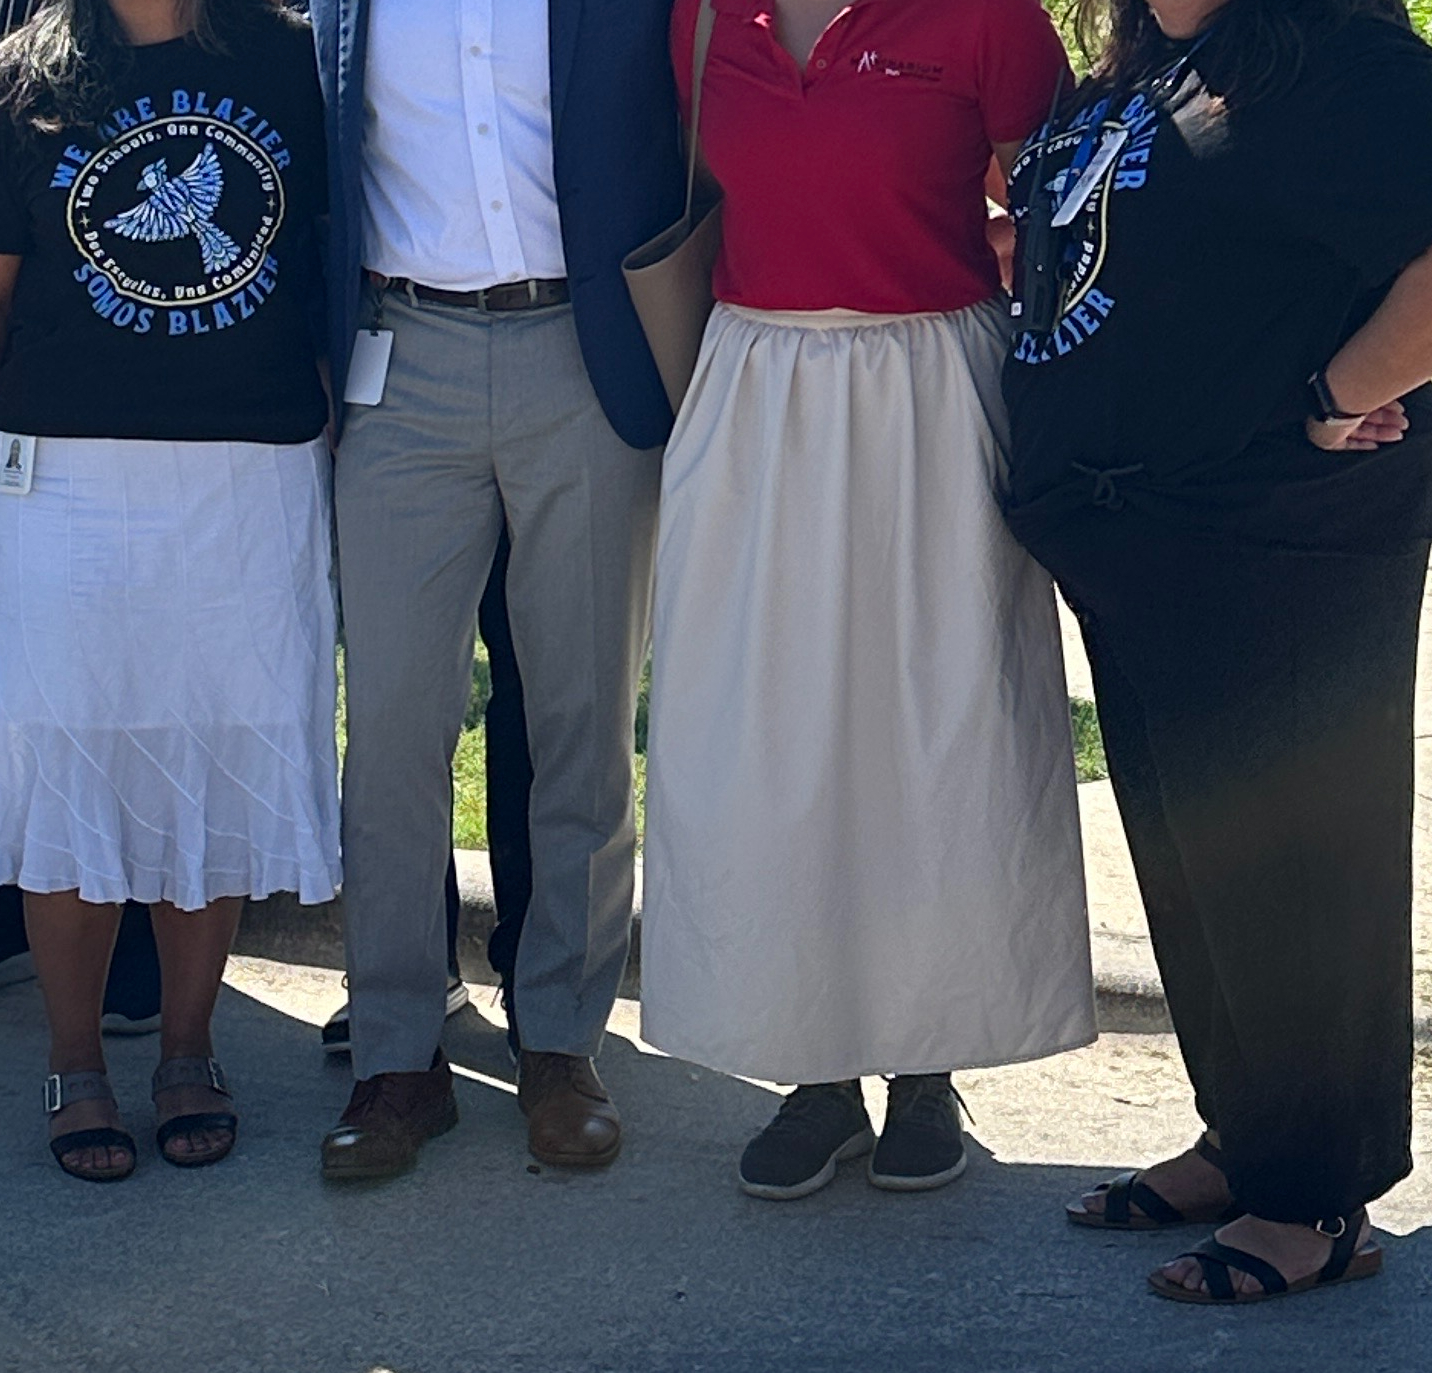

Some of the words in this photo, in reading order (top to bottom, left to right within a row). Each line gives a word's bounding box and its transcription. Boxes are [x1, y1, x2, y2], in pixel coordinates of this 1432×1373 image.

[49, 143, 92, 189] WE
[97, 96, 158, 141] ARE
[172, 88, 292, 171] BLAZIER
[75, 175, 99, 209] Two
[167, 123, 199, 136] One
[205, 124, 275, 191] Community
[73, 262, 155, 334] SOMOS
[168, 254, 279, 337] BLAZIER
[84, 230, 106, 258] Dos
[174, 284, 207, 300] Una
[212, 215, 274, 290] Comunidad
